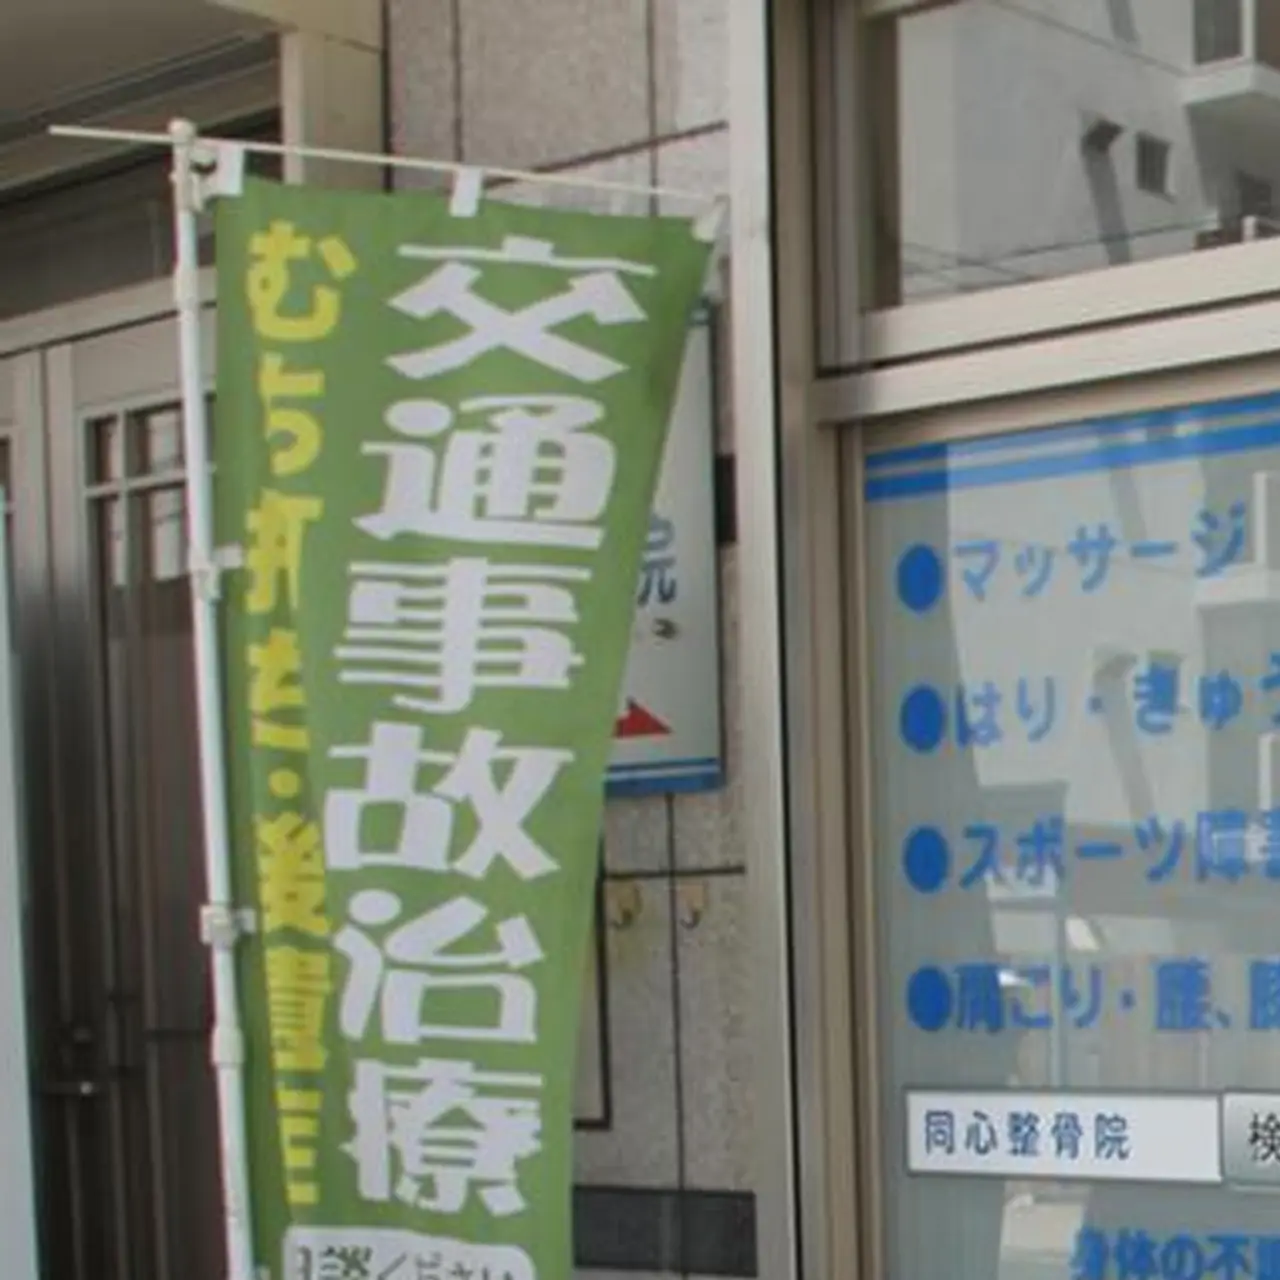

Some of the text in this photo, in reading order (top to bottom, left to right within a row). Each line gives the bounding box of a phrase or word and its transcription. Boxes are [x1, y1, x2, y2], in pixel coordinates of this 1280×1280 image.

[952, 501, 1247, 601] マッサージ
[323, 236, 657, 1215] 交通事故治療
[924, 1109, 1131, 1162] 同心整骨院
